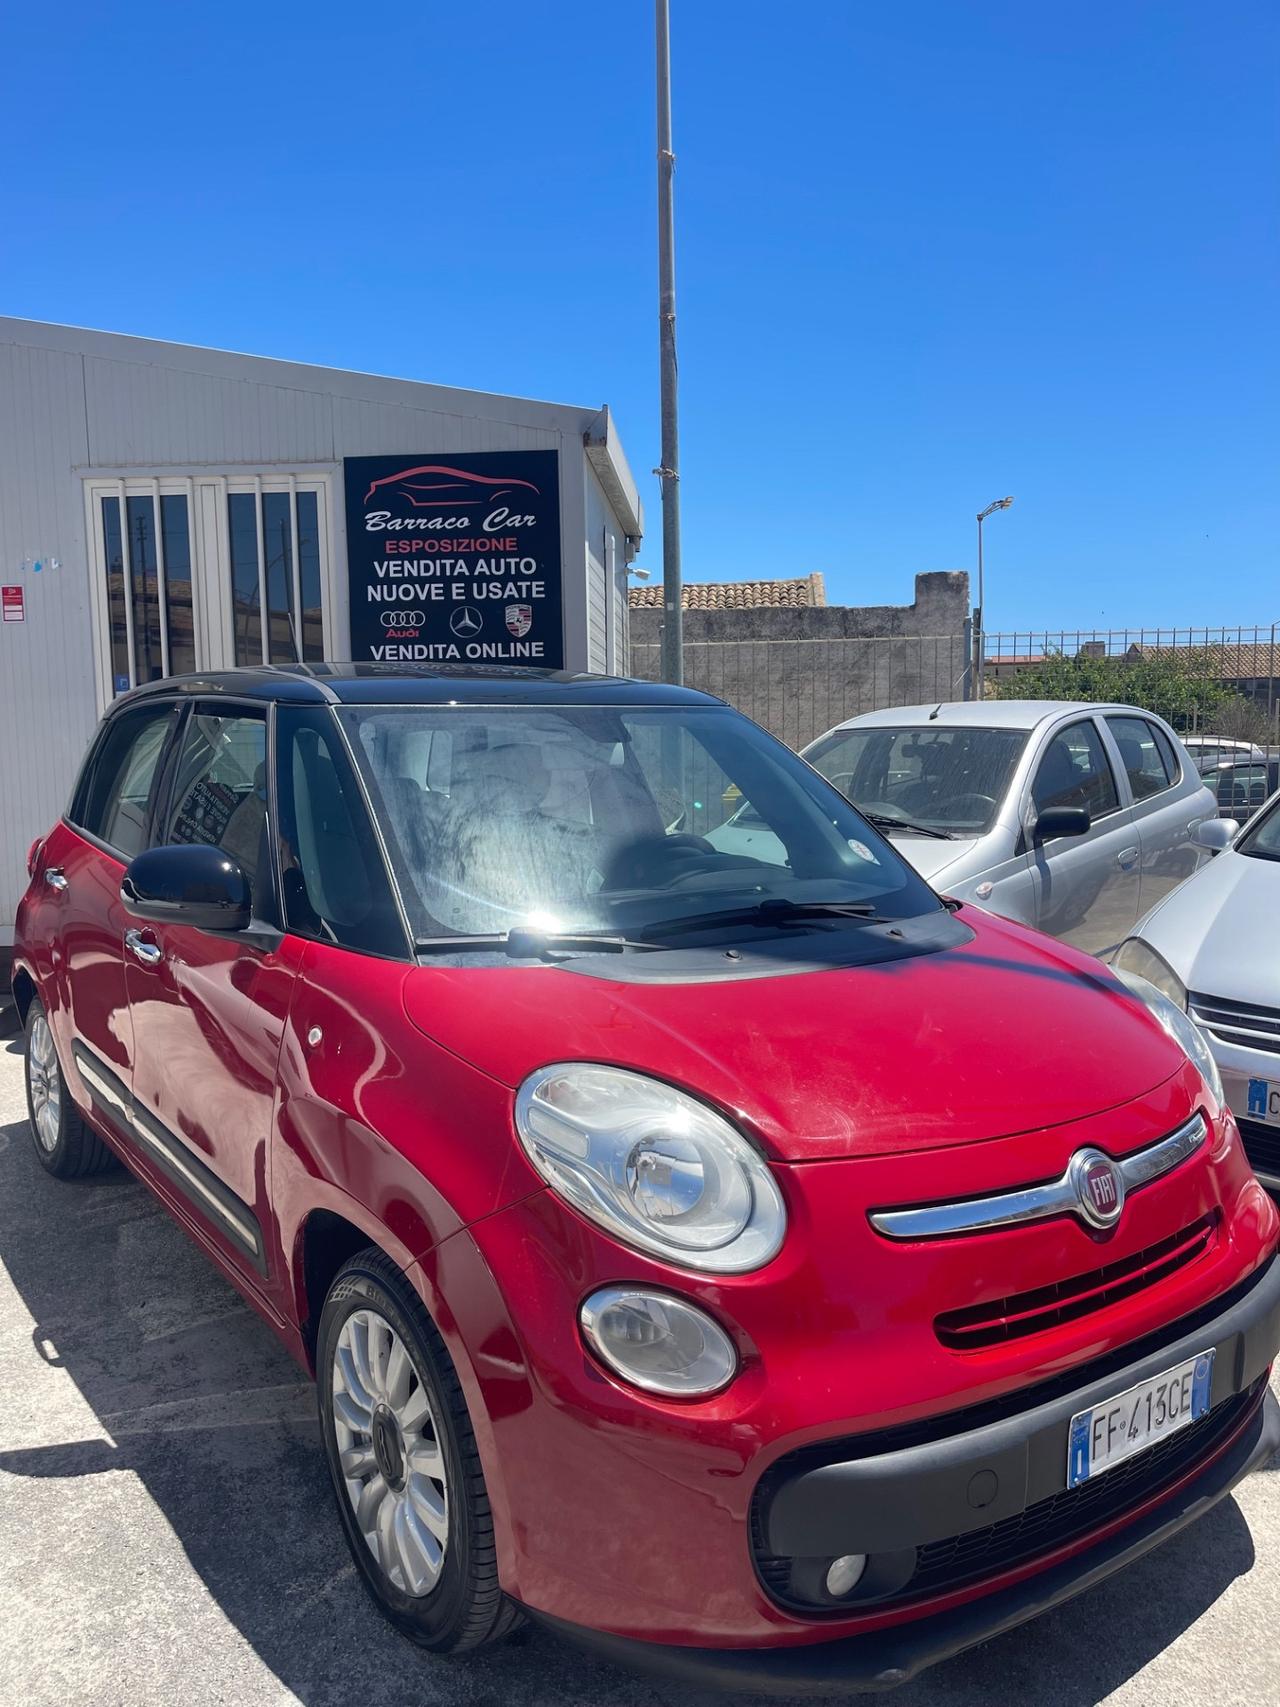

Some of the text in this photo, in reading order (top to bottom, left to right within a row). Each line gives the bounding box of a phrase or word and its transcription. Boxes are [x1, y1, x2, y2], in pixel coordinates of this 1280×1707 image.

[364, 507, 537, 532] Barraco Car
[385, 537, 518, 554] ESPOSIZIONE
[373, 557, 537, 578] VENDITA AUTO
[367, 581, 546, 602] NUOVE E USATE
[385, 628, 420, 638] Audi
[370, 642, 545, 660] VENDITA ONLINE
[1091, 1173, 1116, 1206] FIAT
